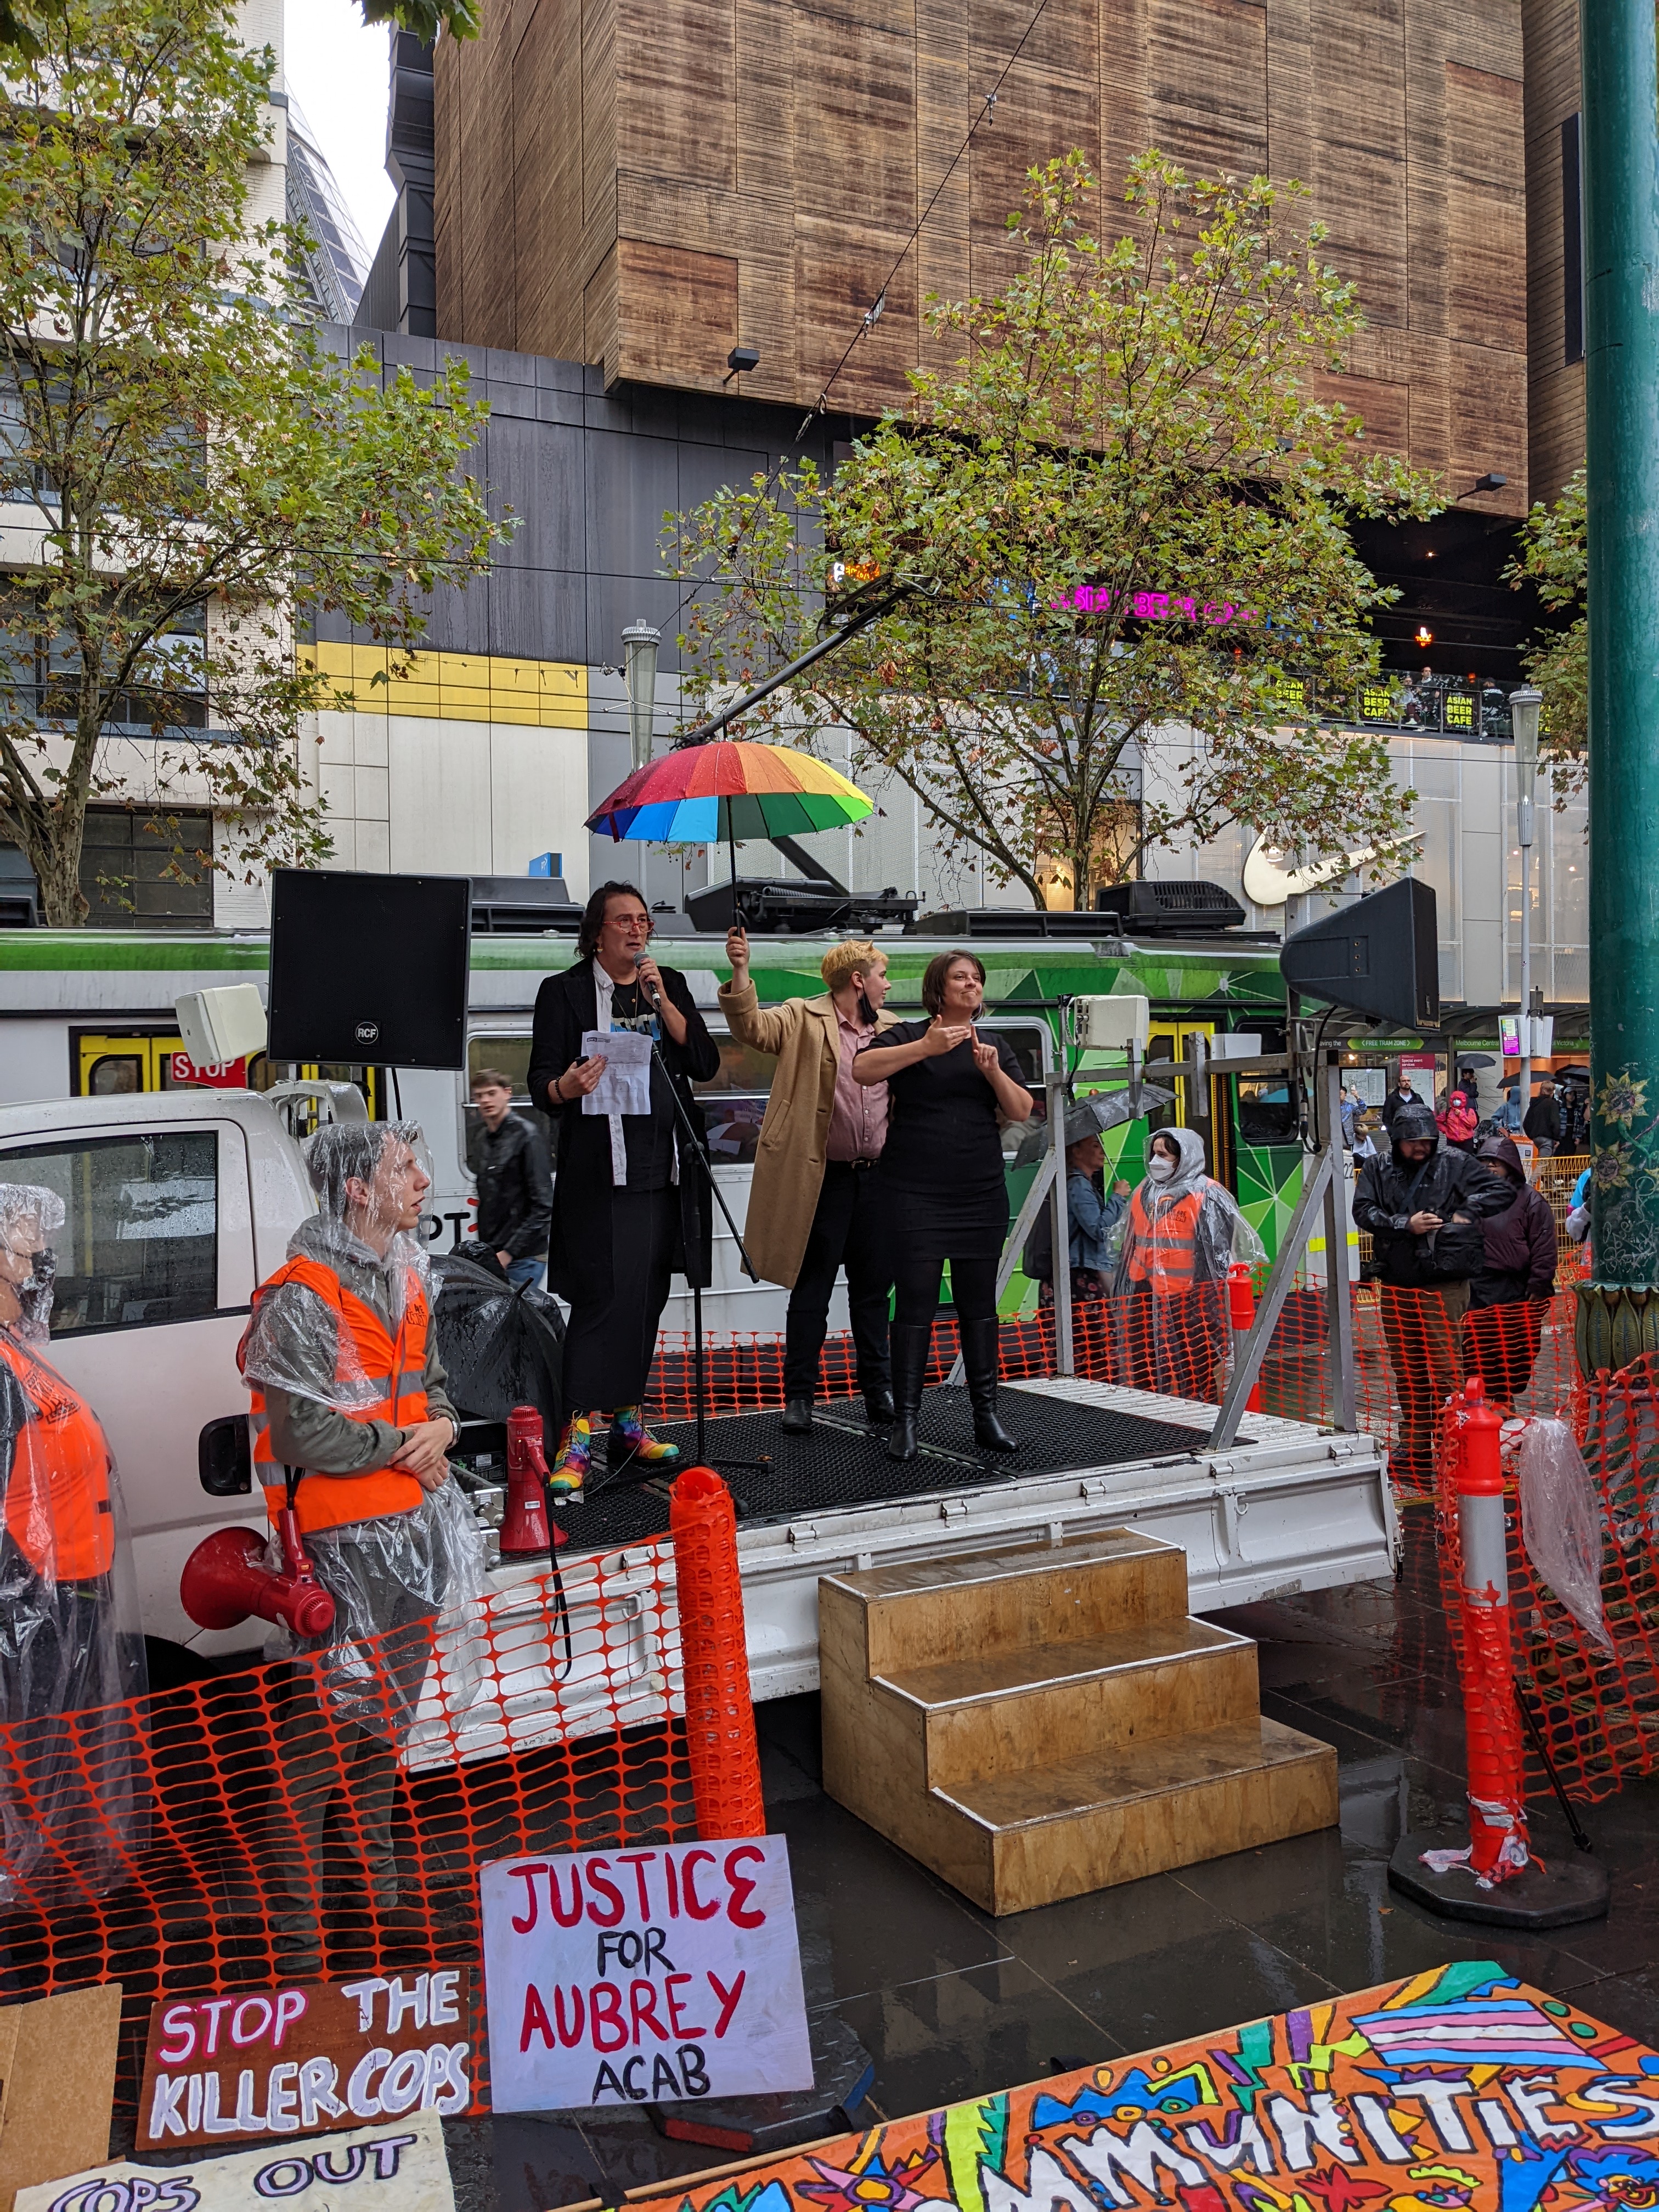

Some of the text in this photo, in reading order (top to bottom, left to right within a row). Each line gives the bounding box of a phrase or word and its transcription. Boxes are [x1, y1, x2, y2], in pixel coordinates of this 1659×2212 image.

[1133, 591, 1197, 623] BER
[1276, 680, 1304, 690] AAN
[1446, 696, 1472, 706] ASIAN
[1364, 697, 1390, 707] BEER
[1364, 707, 1388, 718] CAF
[1446, 704, 1472, 715] BEER
[1446, 715, 1472, 725] CAFE
[358, 1028, 376, 1038] RCF
[507, 1845, 766, 1934] JUSTICE
[597, 1926, 676, 1977] FOR
[157, 1970, 461, 2067] STOP THE
[519, 1970, 746, 2053] AUBREY
[592, 2043, 711, 2104] ACAB
[149, 2042, 470, 2140] KILLER COPS
[48, 2134, 419, 2212] COPS OUT
